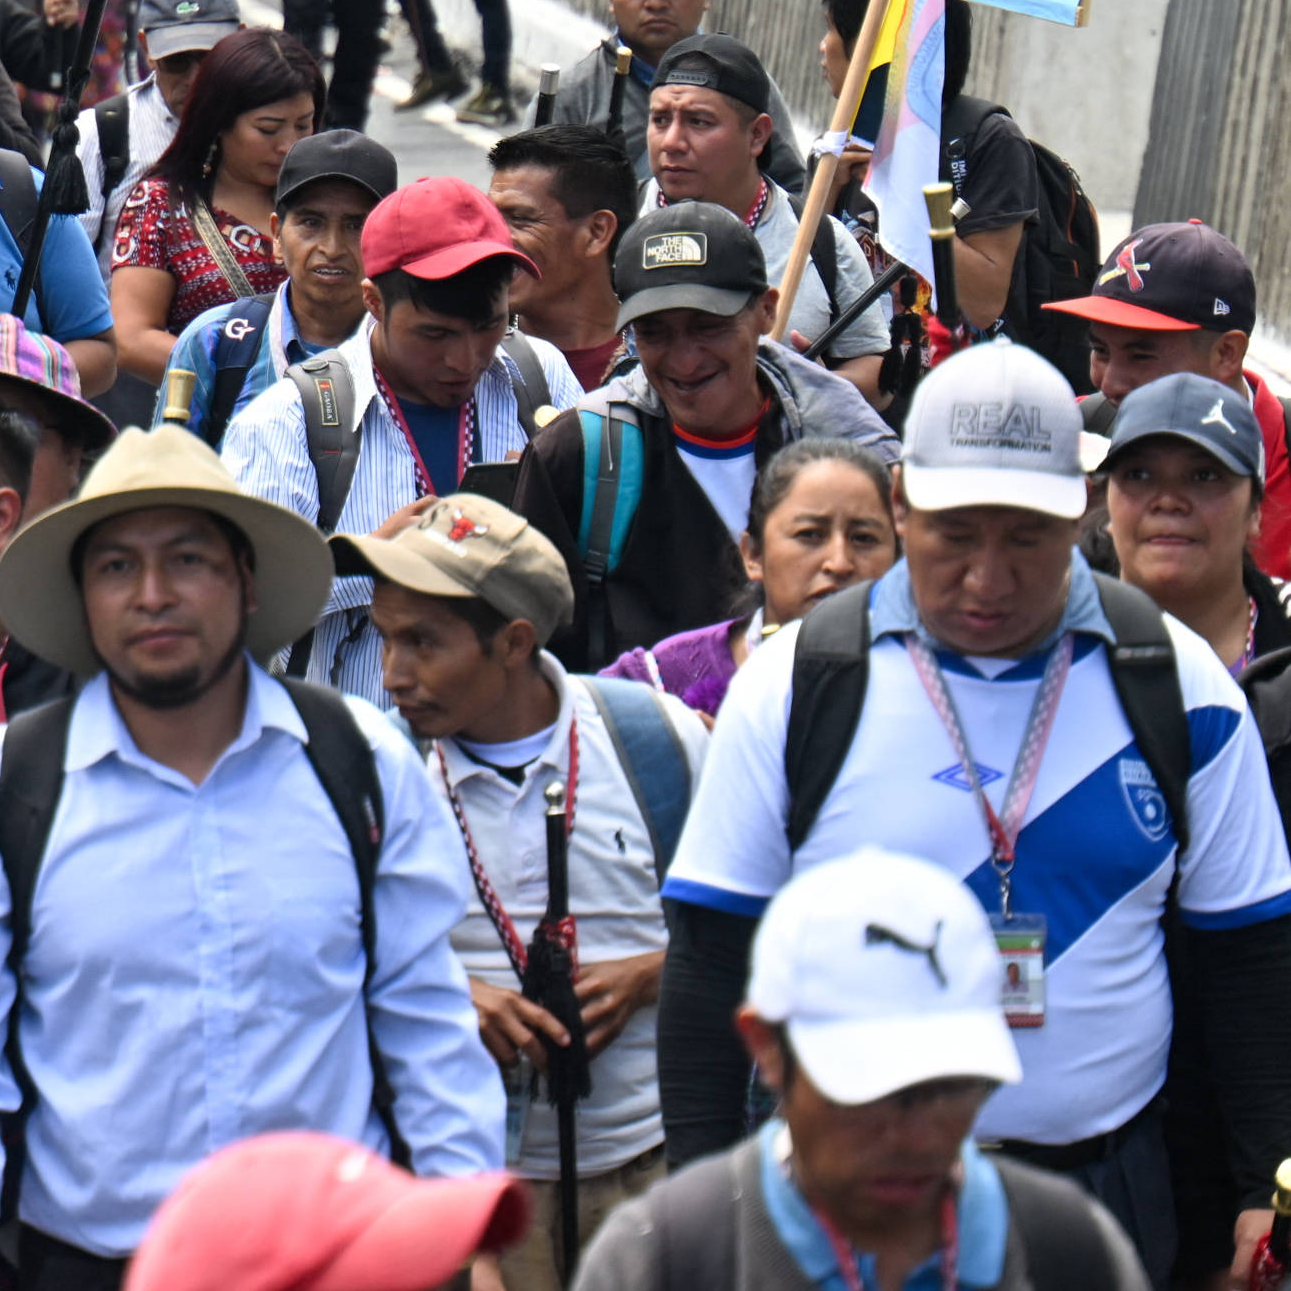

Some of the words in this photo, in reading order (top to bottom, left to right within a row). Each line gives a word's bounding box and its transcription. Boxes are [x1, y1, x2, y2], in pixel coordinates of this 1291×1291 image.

[662, 236, 682, 245] THE
[647, 244, 682, 257] NORTH
[656, 253, 682, 263] FACE
[950, 402, 1051, 440] REAL
[950, 438, 1051, 452] TRANSFORMATION
